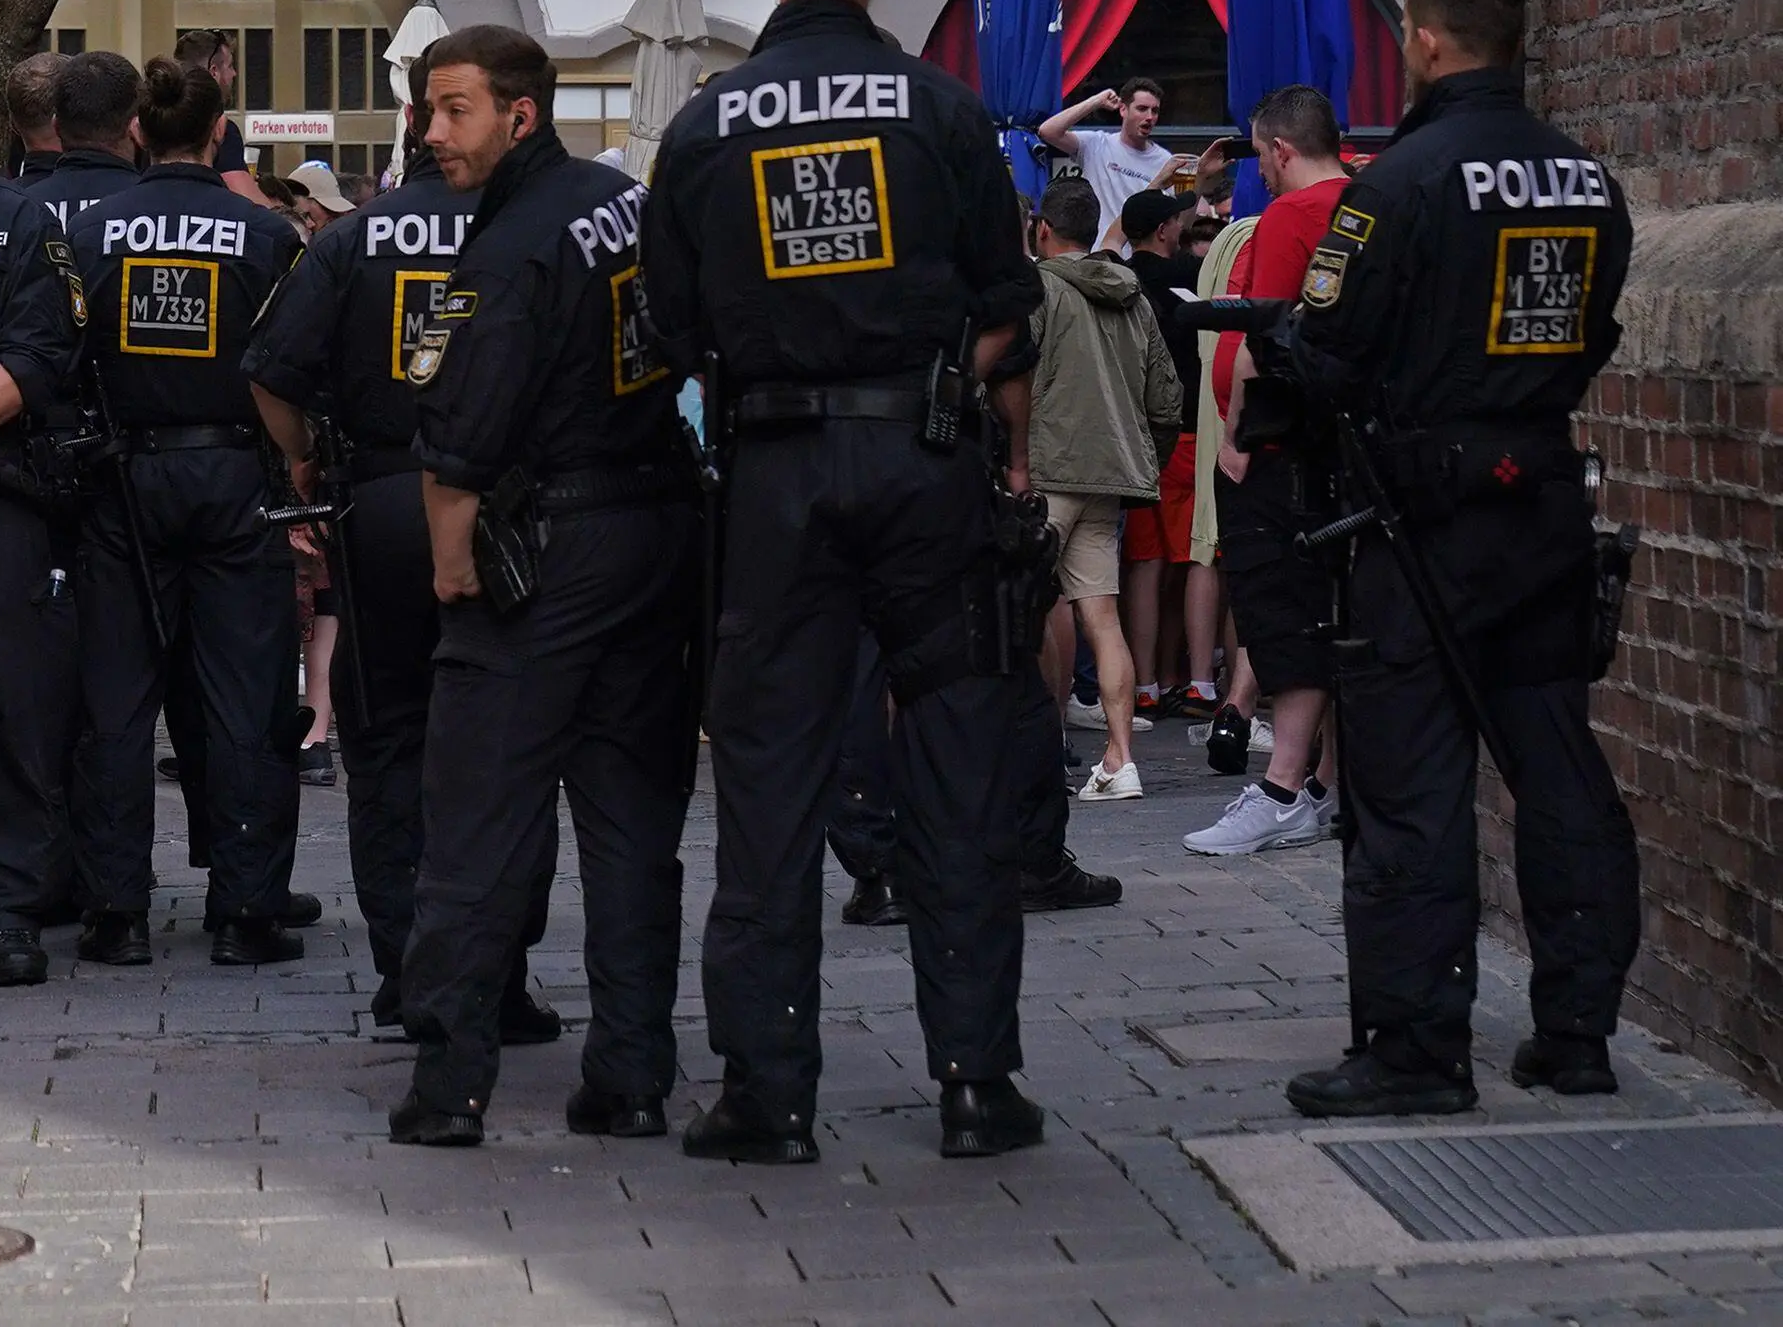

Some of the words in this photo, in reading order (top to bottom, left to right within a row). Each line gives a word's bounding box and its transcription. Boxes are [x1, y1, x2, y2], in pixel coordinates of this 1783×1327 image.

[718, 74, 911, 138] POLIZEI
[252, 121, 285, 134] Parken
[287, 121, 329, 134] verboten
[792, 153, 842, 193] BY
[1460, 158, 1614, 212] POLIZEI
[771, 194, 796, 231] M
[802, 186, 874, 227] 7336
[102, 214, 247, 257] POLIZEI
[366, 213, 475, 257] POLI
[786, 230, 868, 266] BeSi
[1528, 238, 1570, 274] BY
[152, 267, 191, 296] BY
[132, 295, 148, 321] M
[155, 295, 206, 324] 7332
[1507, 316, 1575, 344] BeSi
